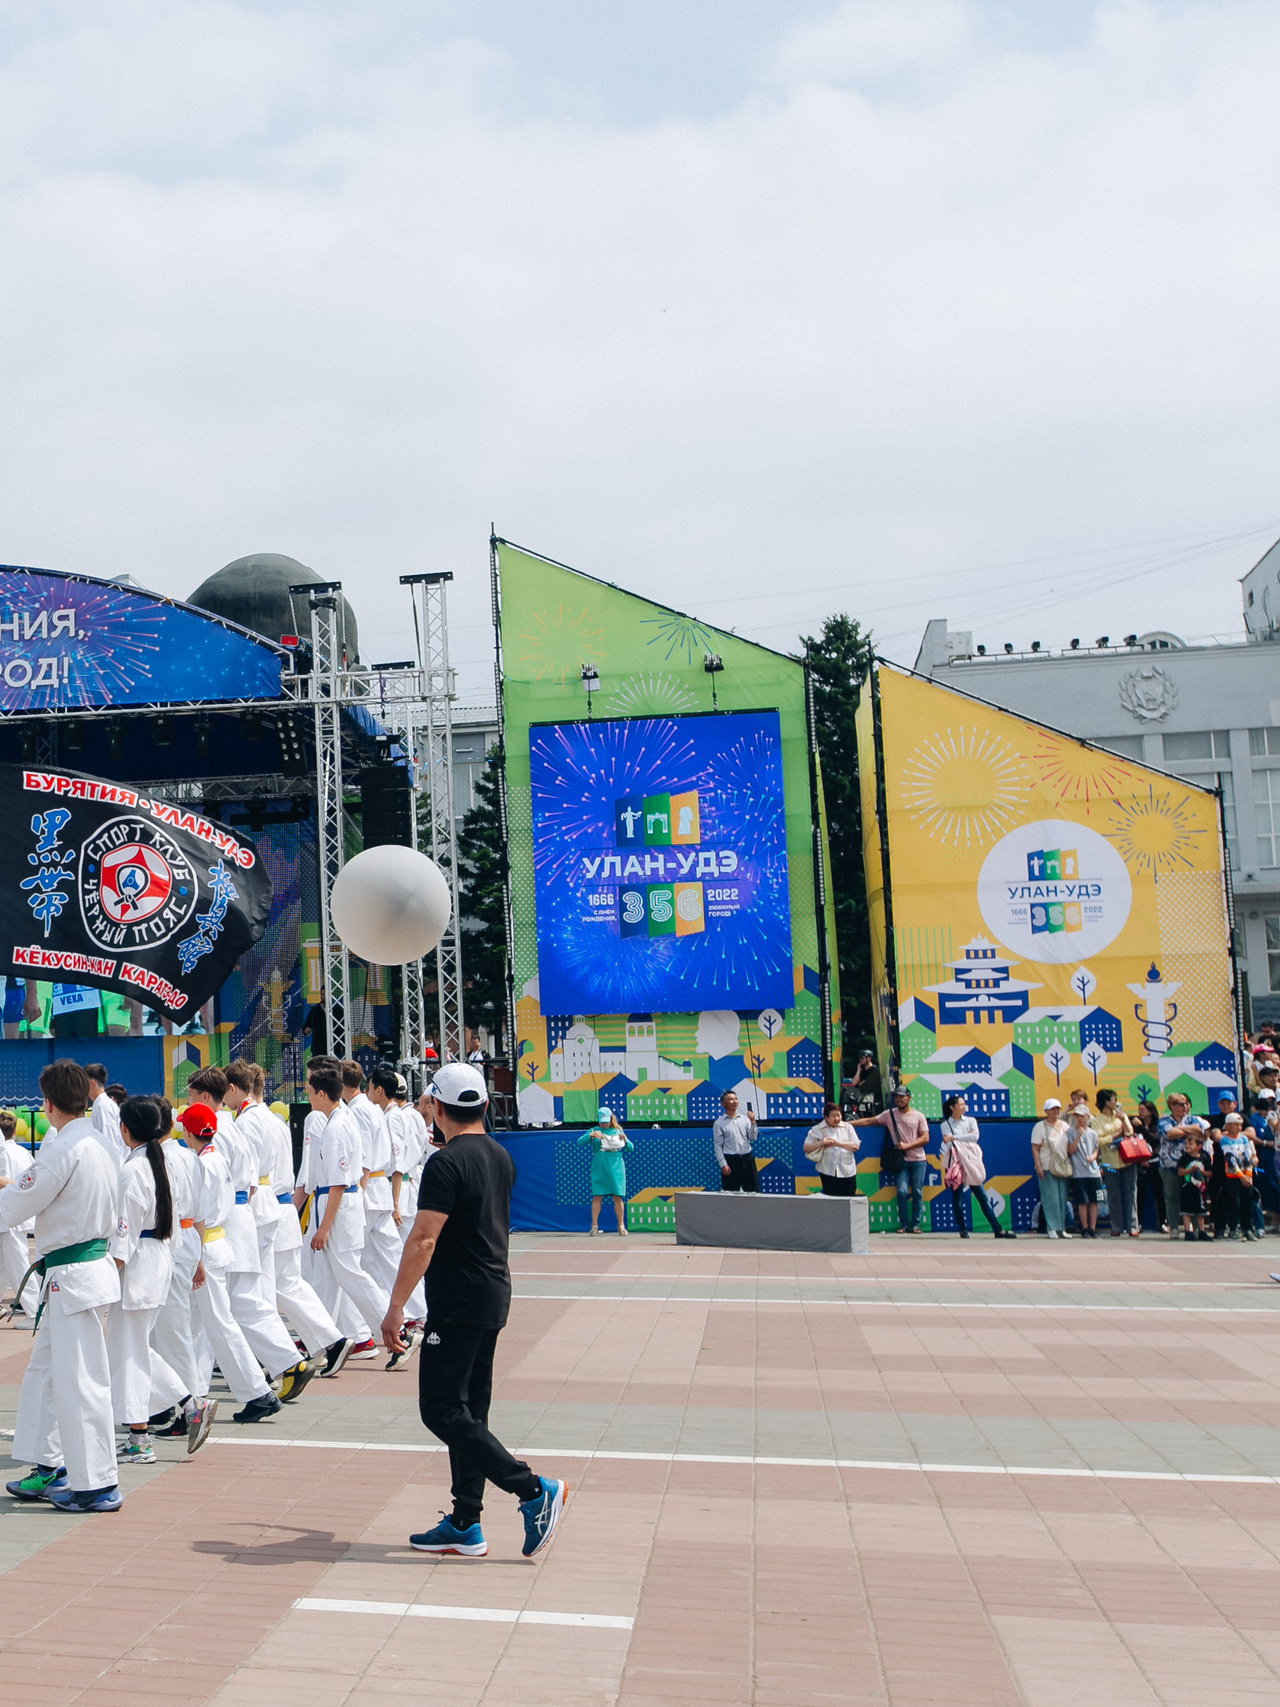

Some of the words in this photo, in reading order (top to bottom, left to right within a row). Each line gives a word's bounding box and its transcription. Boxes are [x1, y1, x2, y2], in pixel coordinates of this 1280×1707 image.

[23, 771, 139, 808] БУРЯТИЯ
[149, 802, 255, 869] УЛАН-УДЭ
[87, 823, 145, 862] СПОРТ
[148, 831, 191, 881] КЛУБ
[582, 850, 739, 879] УЛАН-УДЭ
[587, 893, 615, 906] 1666
[706, 887, 739, 901] 2022
[1007, 884, 1102, 899] УЛАН-УДЭ
[83, 878, 128, 945] ЧЁРНЫЙ
[131, 896, 188, 944] ПОЯС
[12, 945, 117, 979] КЁКУСИН-КАН
